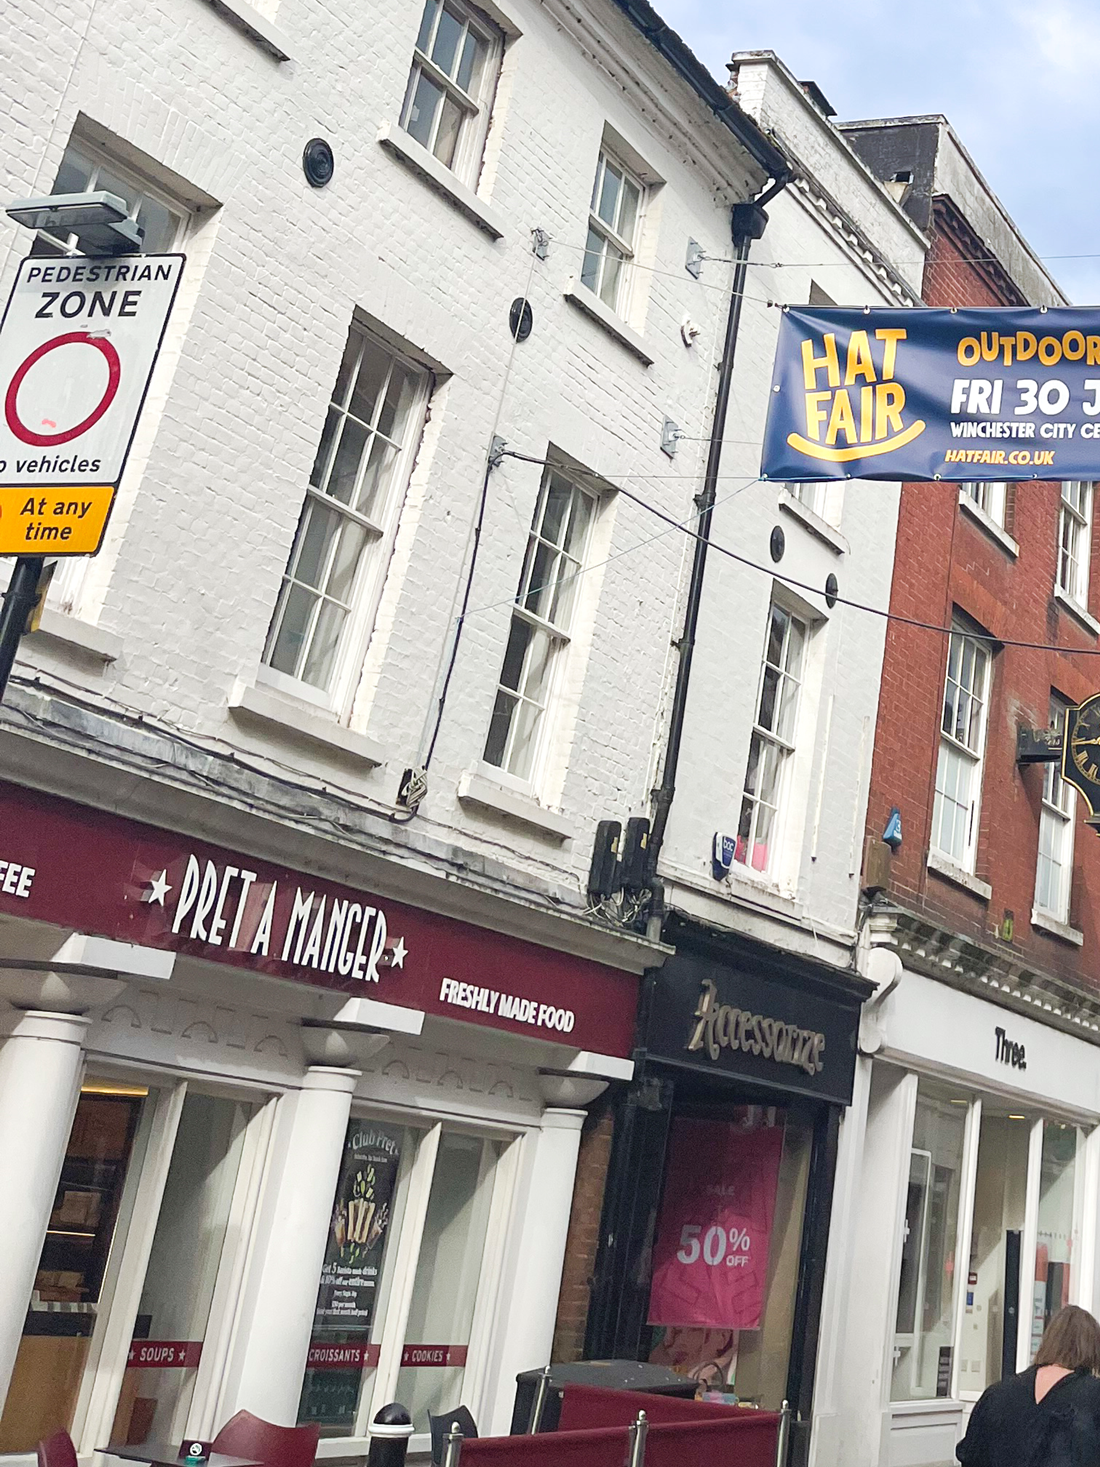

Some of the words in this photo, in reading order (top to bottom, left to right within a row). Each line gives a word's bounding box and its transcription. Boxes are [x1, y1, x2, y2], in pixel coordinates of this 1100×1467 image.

[27, 264, 172, 283] PEDESTRIAN
[34, 290, 142, 319] ZONE
[801, 328, 908, 390] HAT
[950, 379, 1004, 415] FRI
[1014, 379, 1070, 415] 30
[804, 381, 907, 446] FAIR
[950, 421, 1036, 439] WINCHESTER
[1039, 422, 1077, 439] CITY
[16, 454, 102, 473] vehicles
[944, 448, 1056, 466] HATFAIR.CO.UK
[20, 497, 48, 516] At
[52, 501, 93, 519] any
[25, 521, 73, 541] time
[171, 853, 257, 949] PRET
[250, 880, 278, 957] A
[281, 886, 388, 984] MANGER
[439, 977, 500, 1014] FRESHLY
[498, 993, 539, 1024] MADE
[537, 1004, 575, 1033] FOOD
[687, 978, 826, 1077] Accessorize
[352, 1129, 376, 1151] Club
[726, 1254, 750, 1267] OFF
[139, 1346, 175, 1362] SOUPS
[308, 1348, 361, 1362] CROISSANTS
[411, 1349, 444, 1362] COOKIES
